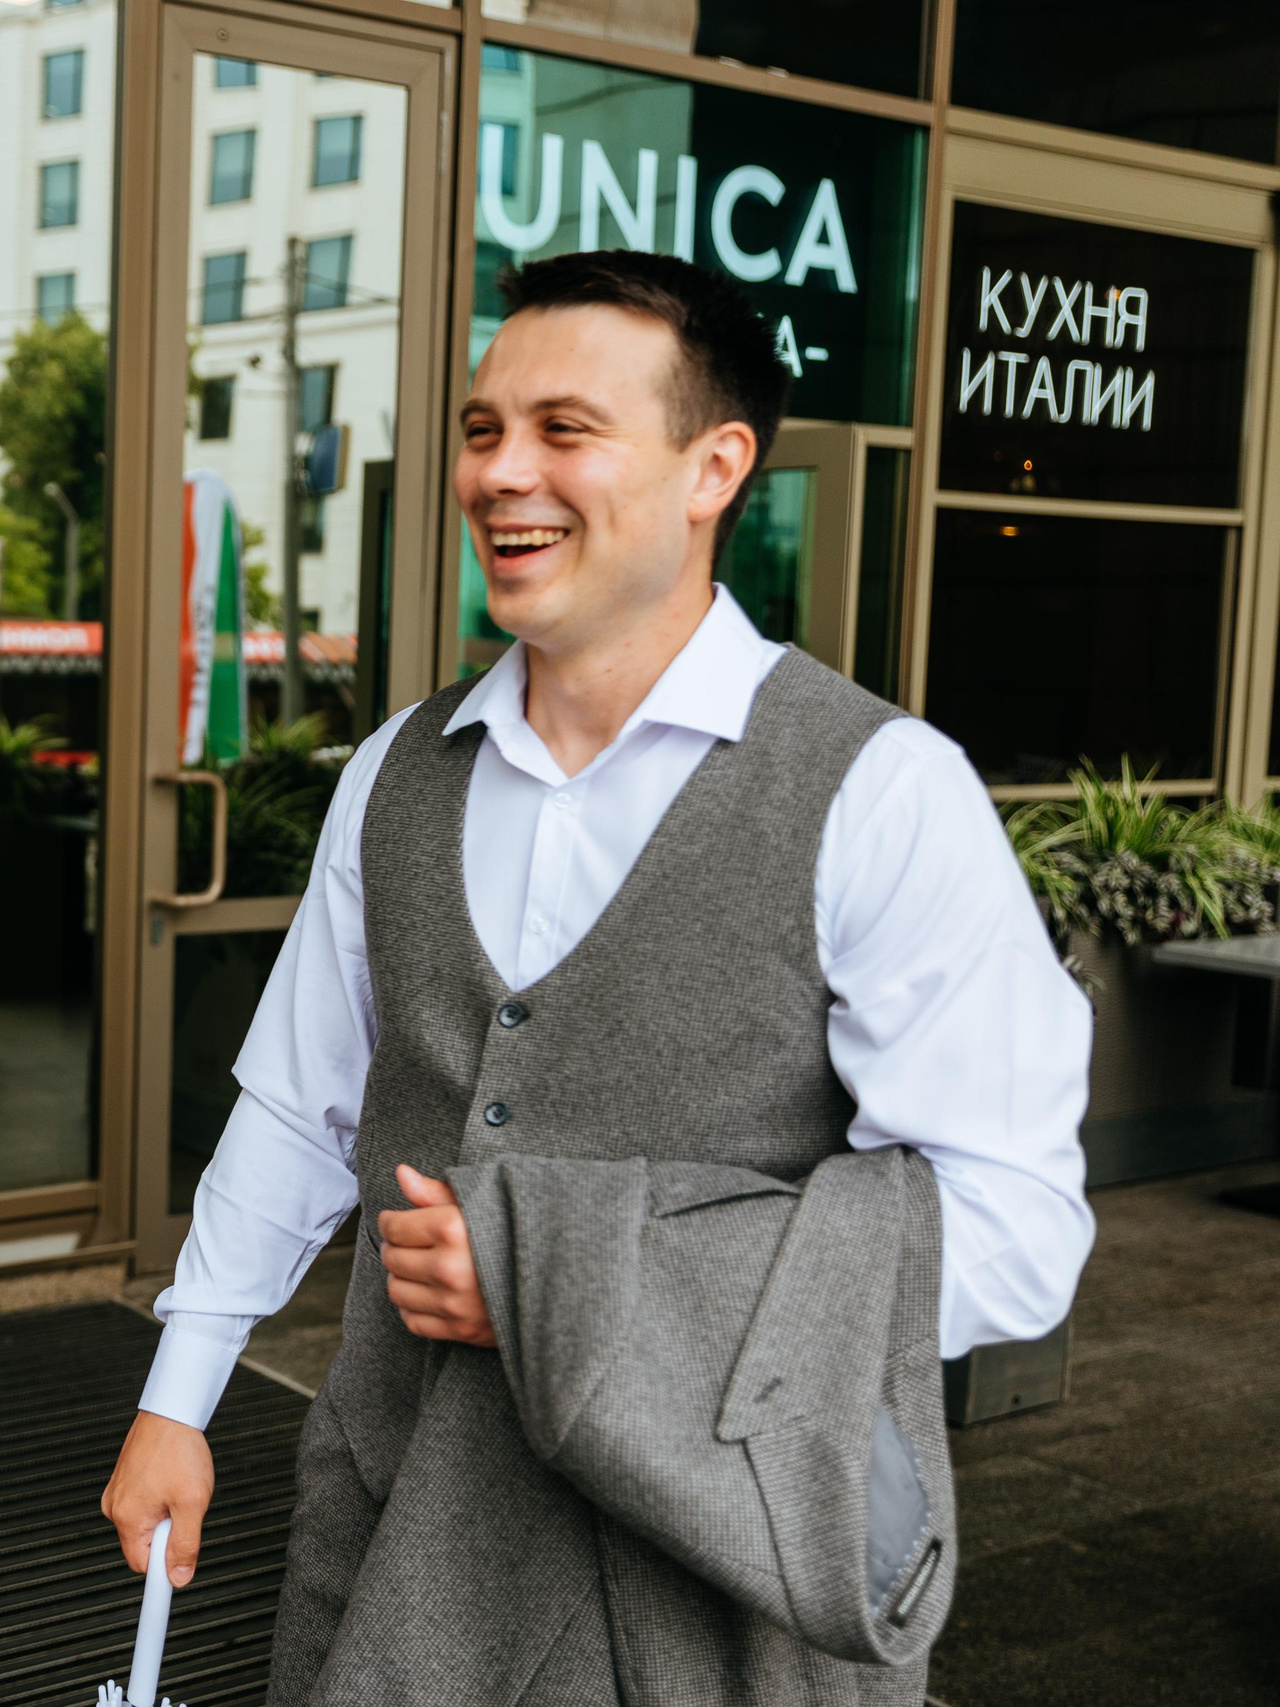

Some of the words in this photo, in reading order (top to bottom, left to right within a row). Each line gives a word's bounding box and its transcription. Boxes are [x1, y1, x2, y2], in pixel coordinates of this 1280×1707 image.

[481, 123, 858, 294] UNICA
[979, 265, 1149, 352] КУХНЯ
[959, 346, 1155, 432] ИТАЛИИ
